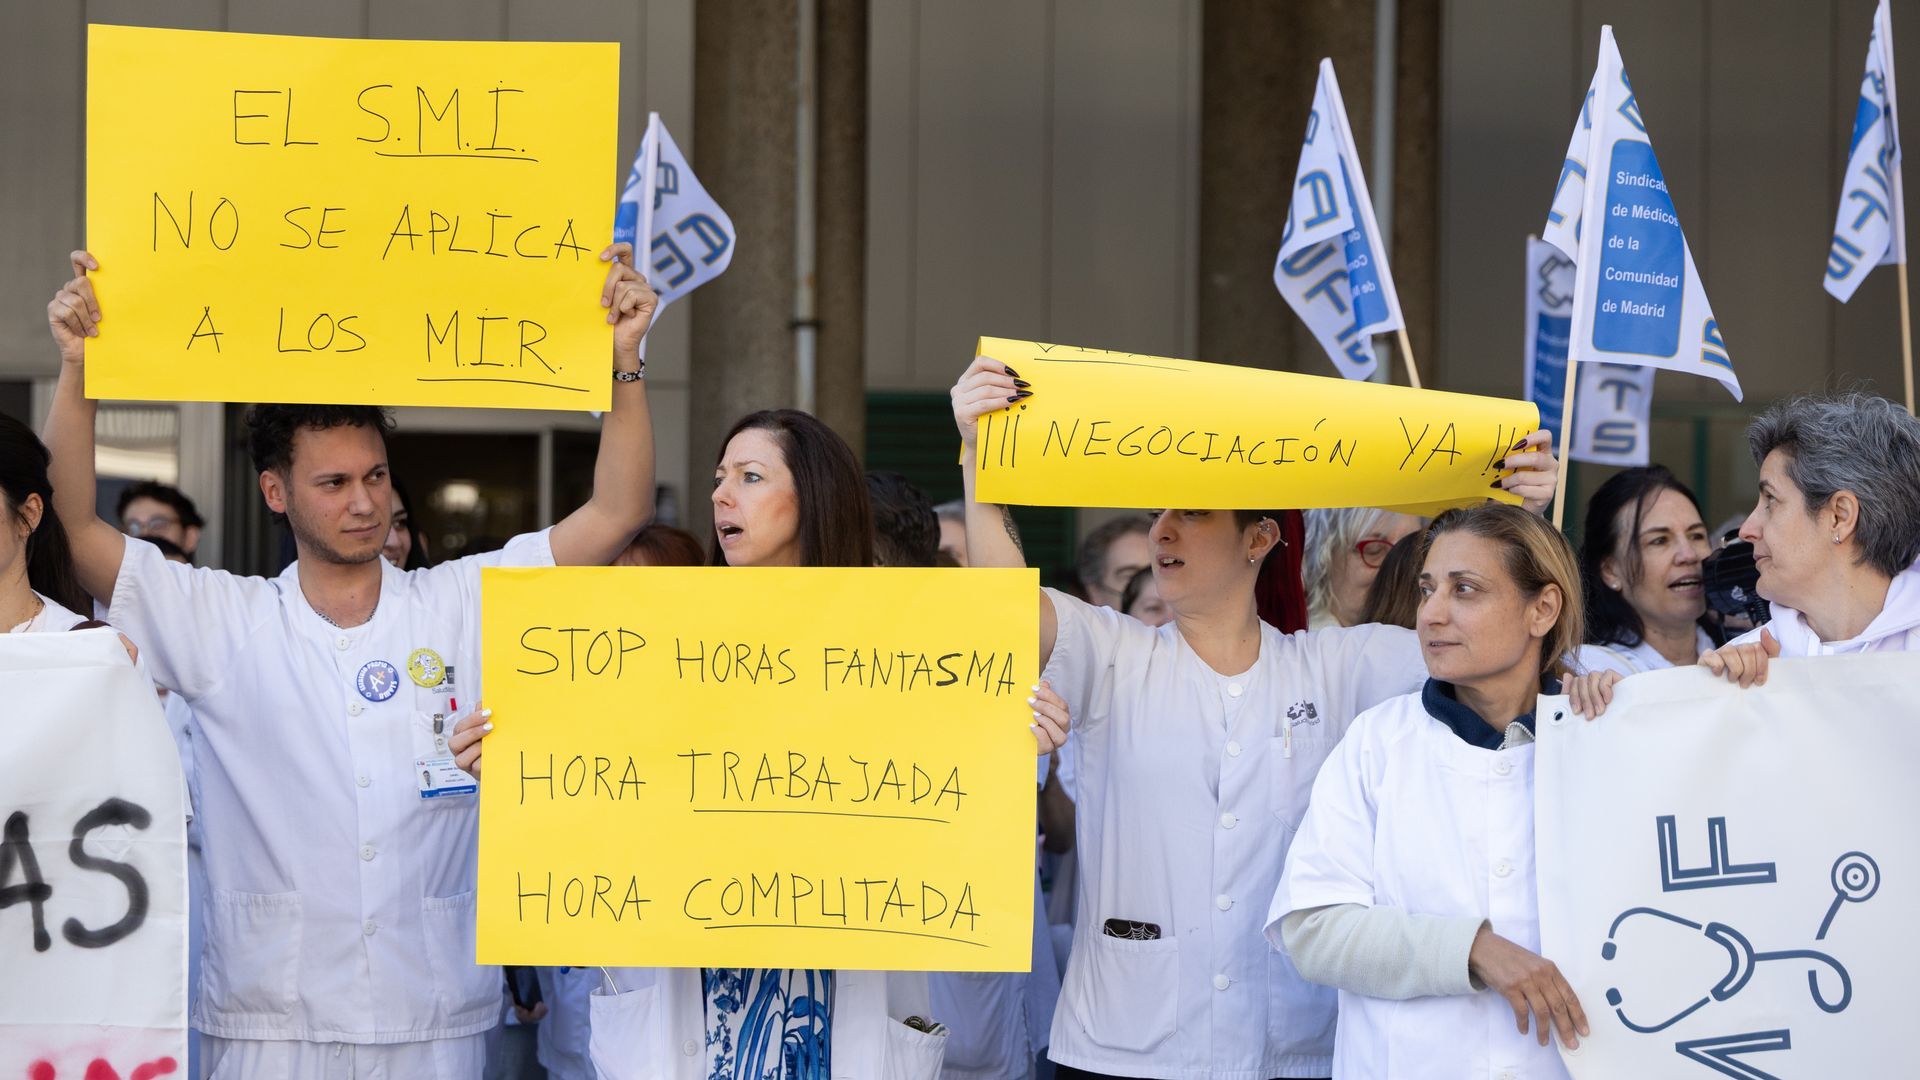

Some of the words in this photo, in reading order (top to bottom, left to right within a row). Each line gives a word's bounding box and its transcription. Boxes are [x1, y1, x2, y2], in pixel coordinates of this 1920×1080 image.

[234, 87, 319, 147] EL
[357, 81, 525, 154] S.M.I.
[153, 191, 239, 252] NO
[279, 206, 346, 249] SE
[382, 205, 592, 261] APLICA
[1612, 203, 1628, 217] de
[1608, 234, 1624, 249] de
[1628, 236, 1640, 250] la
[1605, 266, 1679, 289] Comunidad
[1602, 299, 1617, 313] de
[1620, 300, 1666, 318] Madrid
[187, 306, 224, 353] A
[278, 307, 366, 353] LOS
[426, 309, 563, 374] M.I.R.
[1042, 418, 1358, 467] NEGOCIACIÓN
[1399, 417, 1462, 473] YA
[517, 626, 647, 682] STOP
[676, 638, 797, 686] HORAS
[824, 647, 1016, 697] FANTASMA
[520, 751, 647, 805] HORA
[677, 749, 968, 811] TRABAJADA
[517, 871, 652, 924] HORA
[683, 872, 982, 931] COMPUTADA
